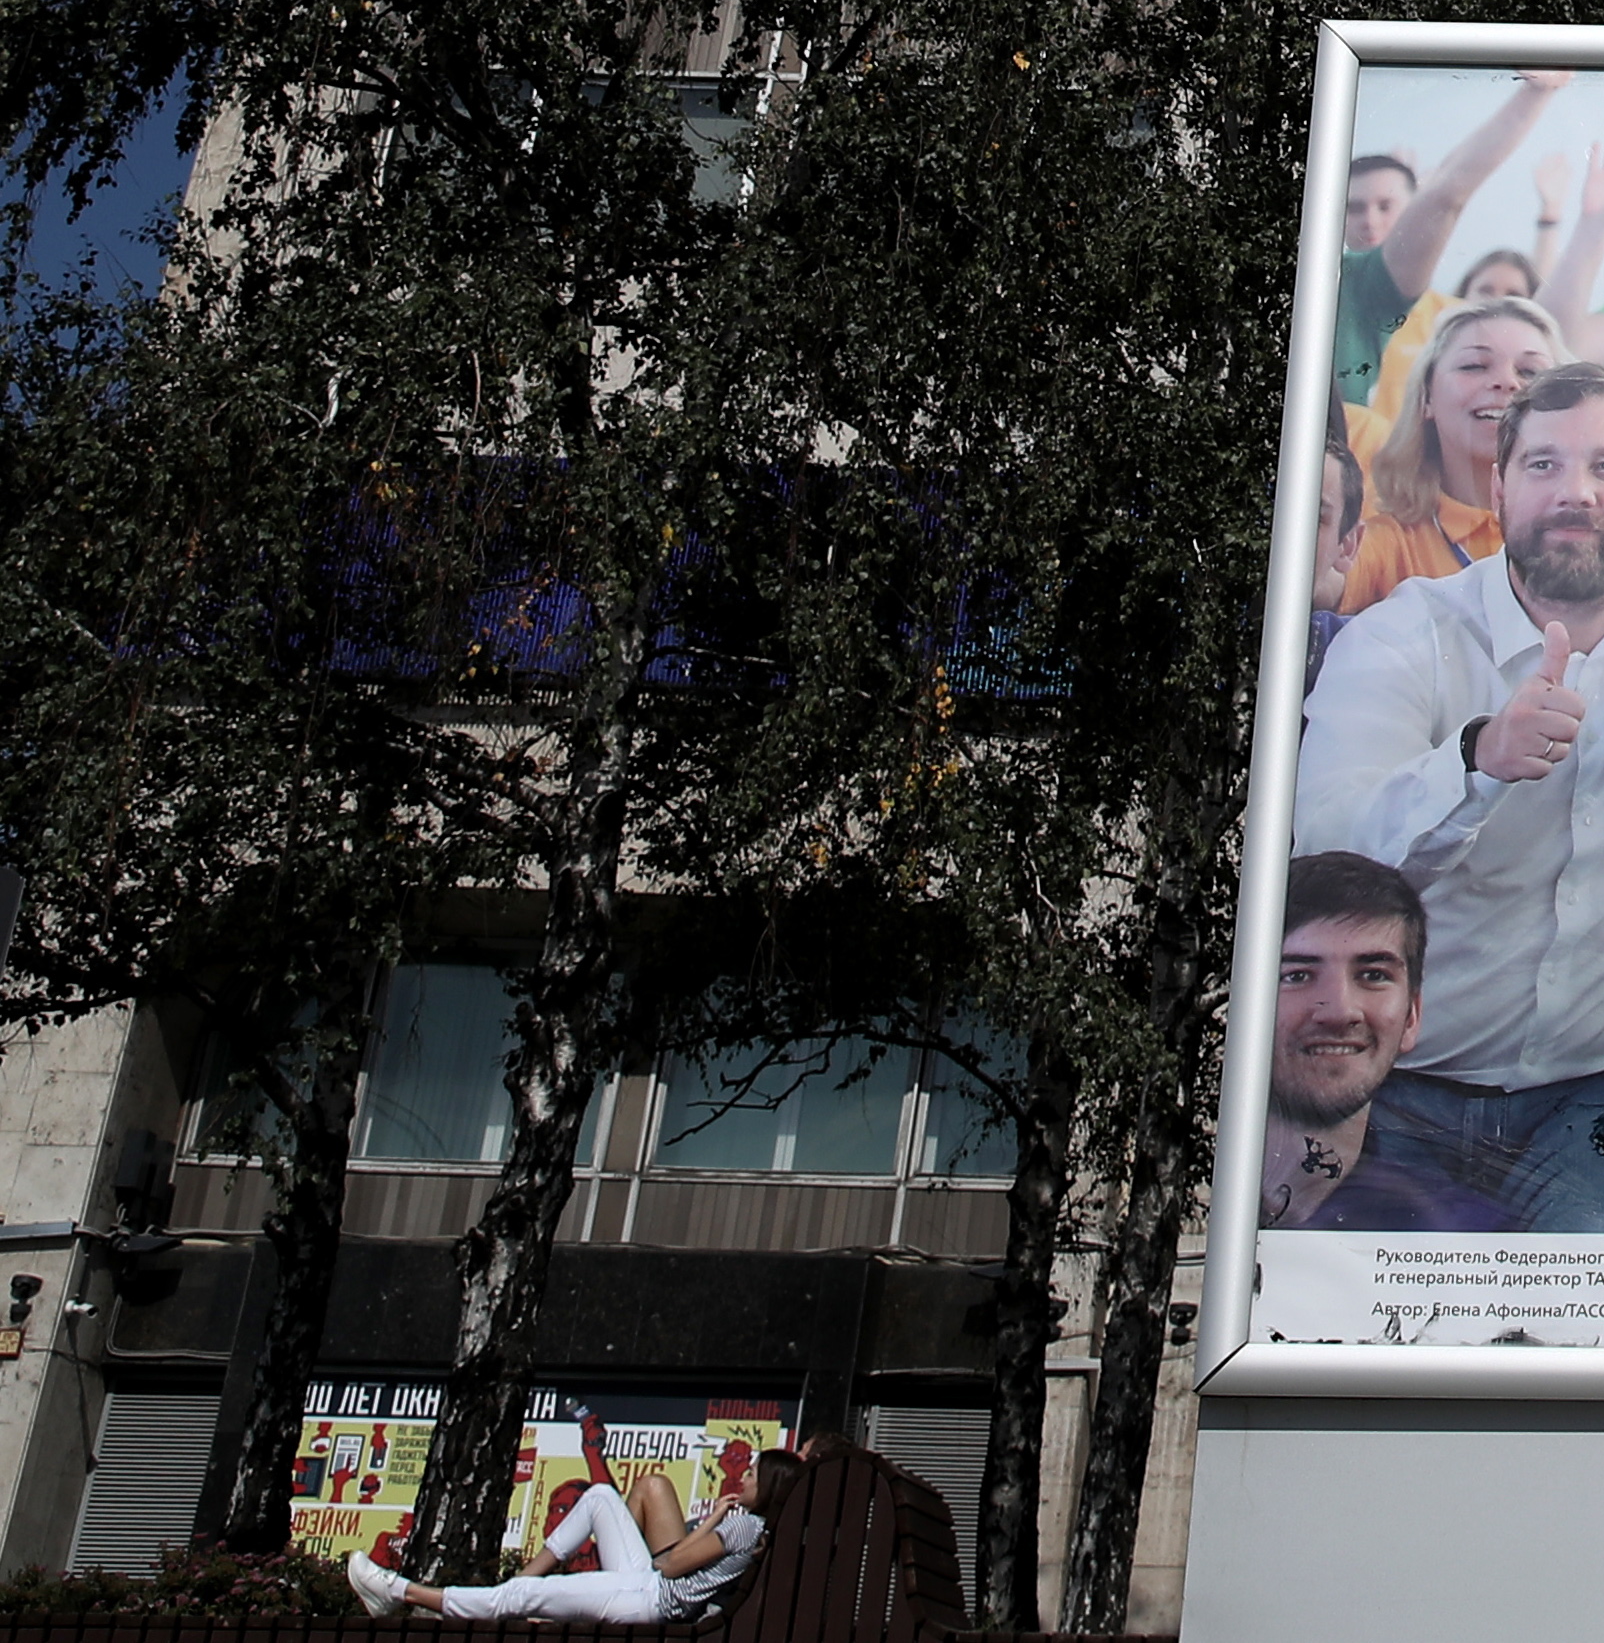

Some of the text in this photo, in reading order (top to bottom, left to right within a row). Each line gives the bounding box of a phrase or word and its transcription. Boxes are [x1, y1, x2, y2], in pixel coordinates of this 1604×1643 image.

[1377, 1248, 1490, 1266] Руководитель
[1375, 1273, 1384, 1283] и
[1390, 1270, 1497, 1288] генеральный
[1502, 1275, 1581, 1289] директор
[1371, 1302, 1428, 1319] Автор:
[1433, 1303, 1481, 1317] Елена
[337, 1381, 387, 1416] ЛЕТ
[605, 1431, 688, 1463] ДОБУДЬ
